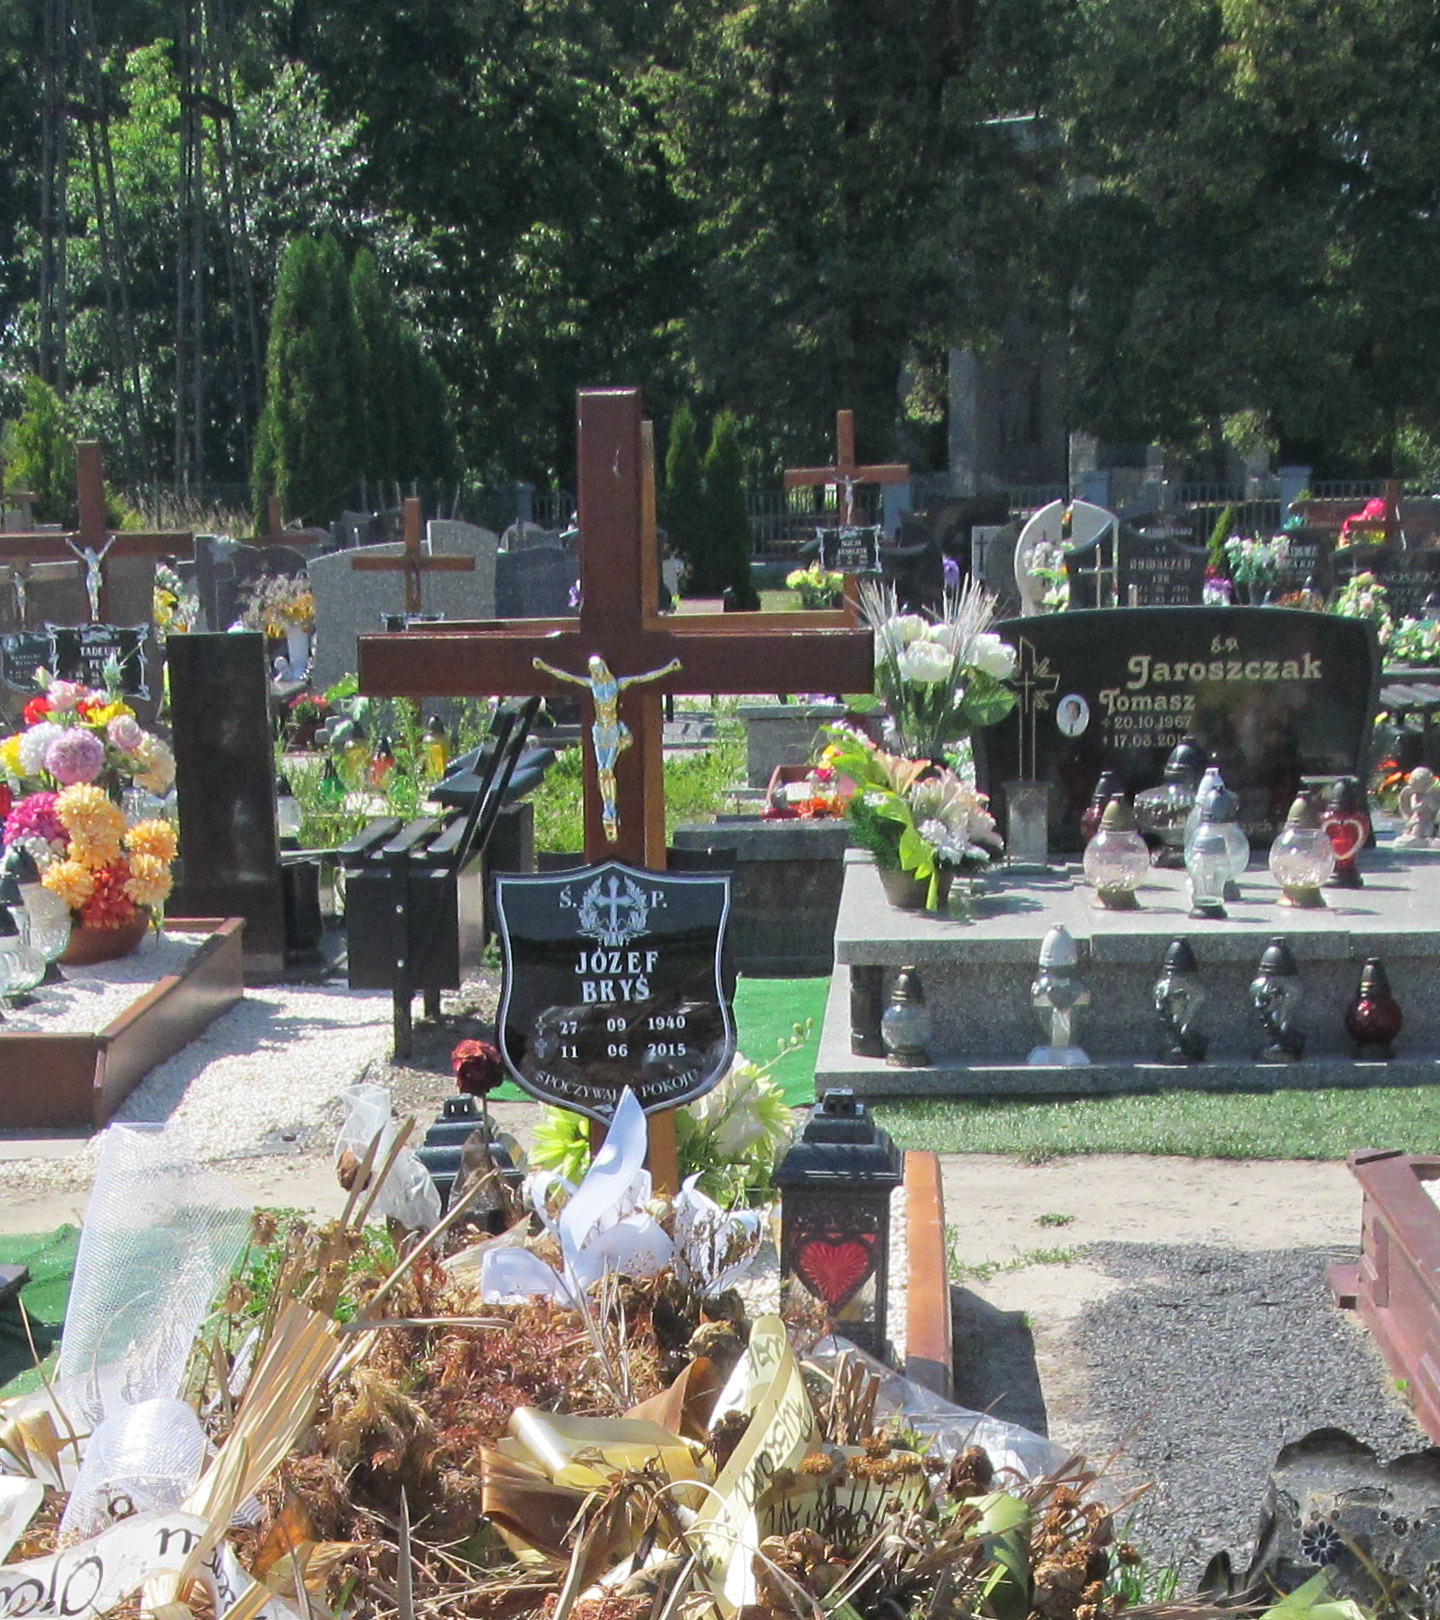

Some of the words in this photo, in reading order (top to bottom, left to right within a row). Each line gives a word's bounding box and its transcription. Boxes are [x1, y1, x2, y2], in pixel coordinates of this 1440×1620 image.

[1126, 653, 1323, 690] Jaroszczak
[1098, 688, 1196, 716] Tomasz
[1113, 733, 1181, 748] 17.03.201
[574, 946, 660, 975] JÓZEF
[582, 973, 651, 1004] BRYŚ
[560, 1020, 578, 1035] 27
[606, 1017, 627, 1032] 09
[647, 1015, 687, 1031] 1940
[560, 1044, 579, 1059] 11
[647, 1042, 687, 1057] 2015
[641, 1067, 699, 1099] POKOJU
